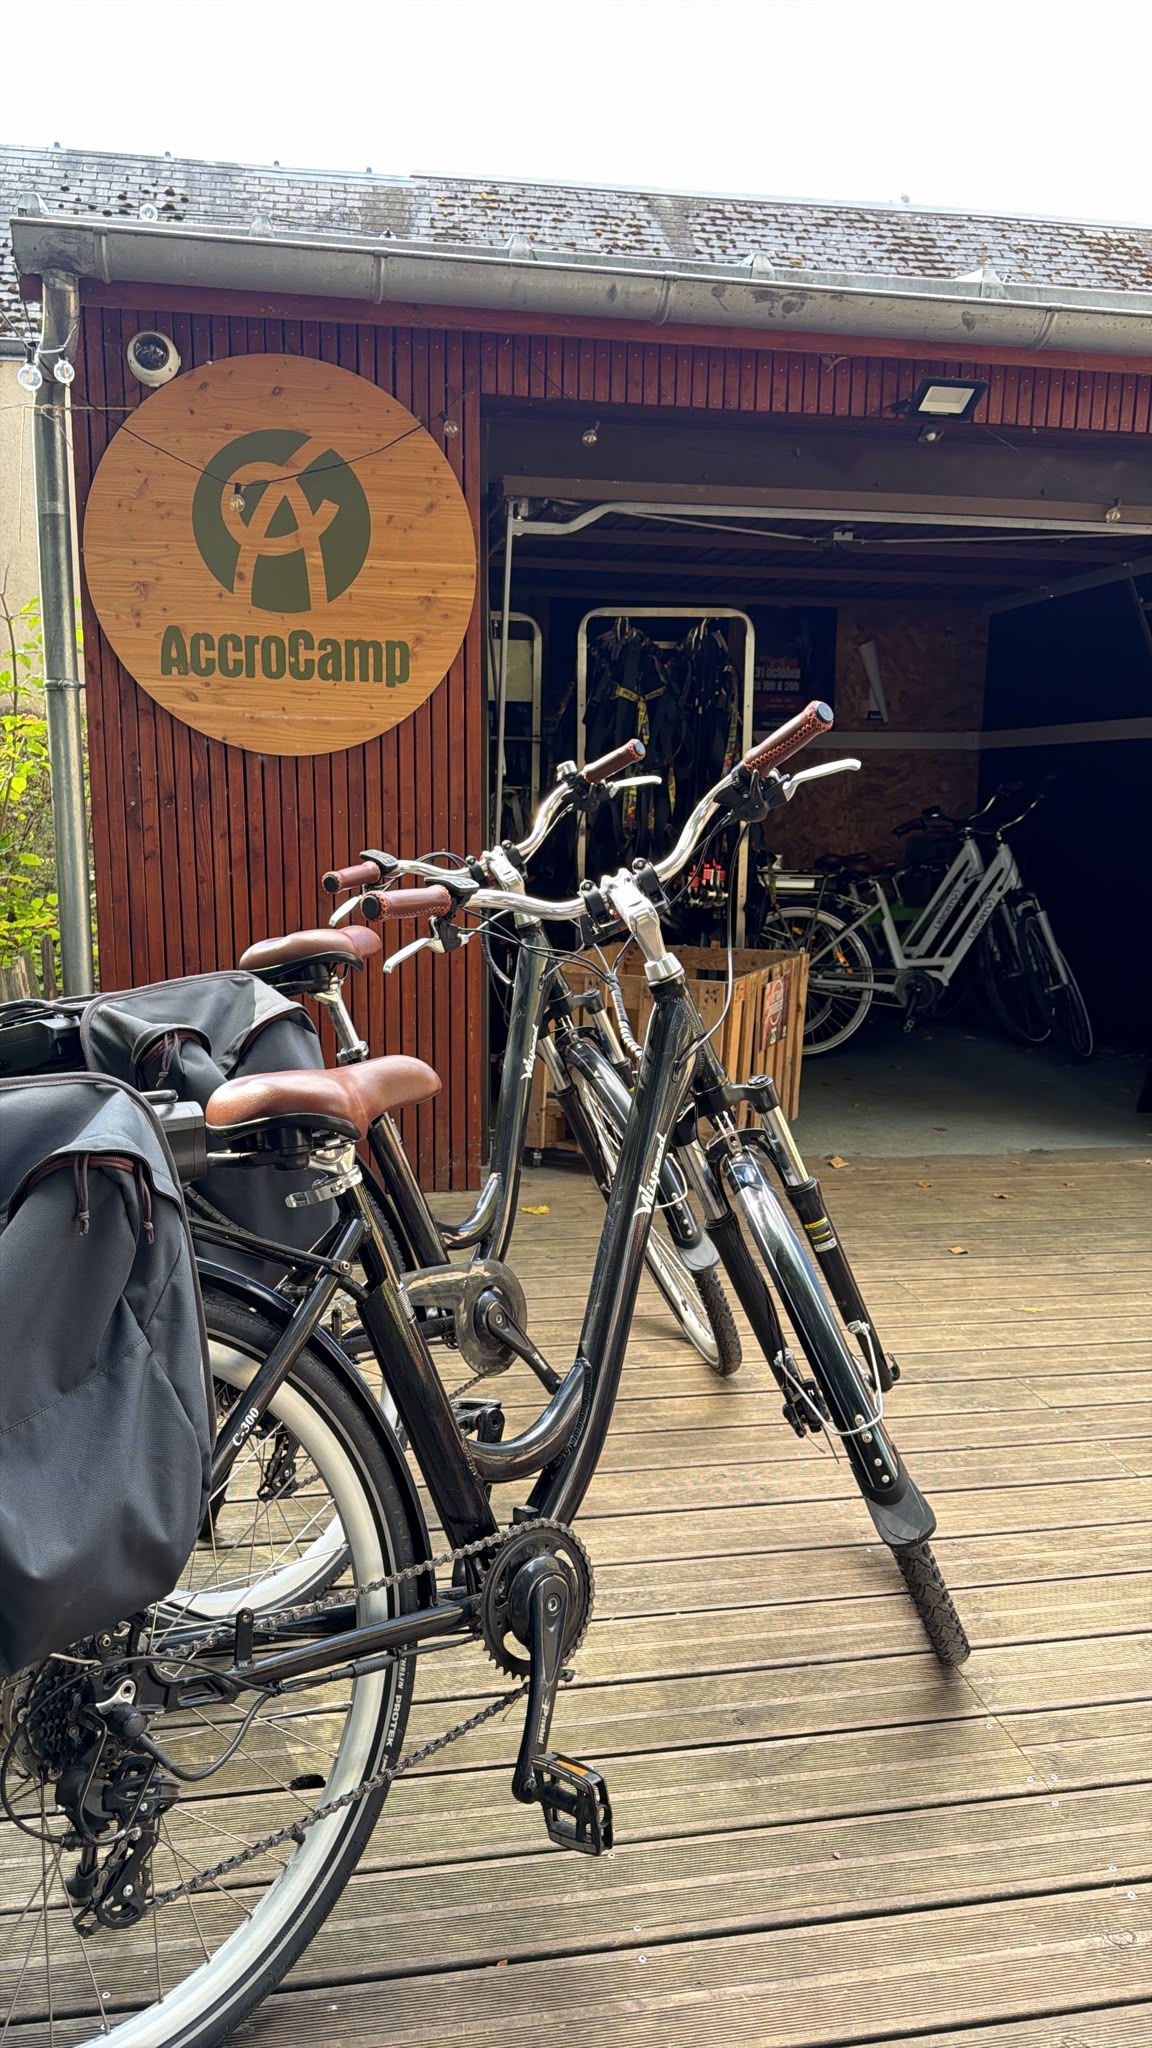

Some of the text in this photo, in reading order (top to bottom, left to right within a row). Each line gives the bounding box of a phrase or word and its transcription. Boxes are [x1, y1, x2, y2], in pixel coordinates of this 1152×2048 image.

[160, 625, 410, 688] AccroCamp
[633, 1131, 667, 1217] Wispeed
[232, 1407, 259, 1447] C-300
[385, 1694, 403, 1748] PROTEK
